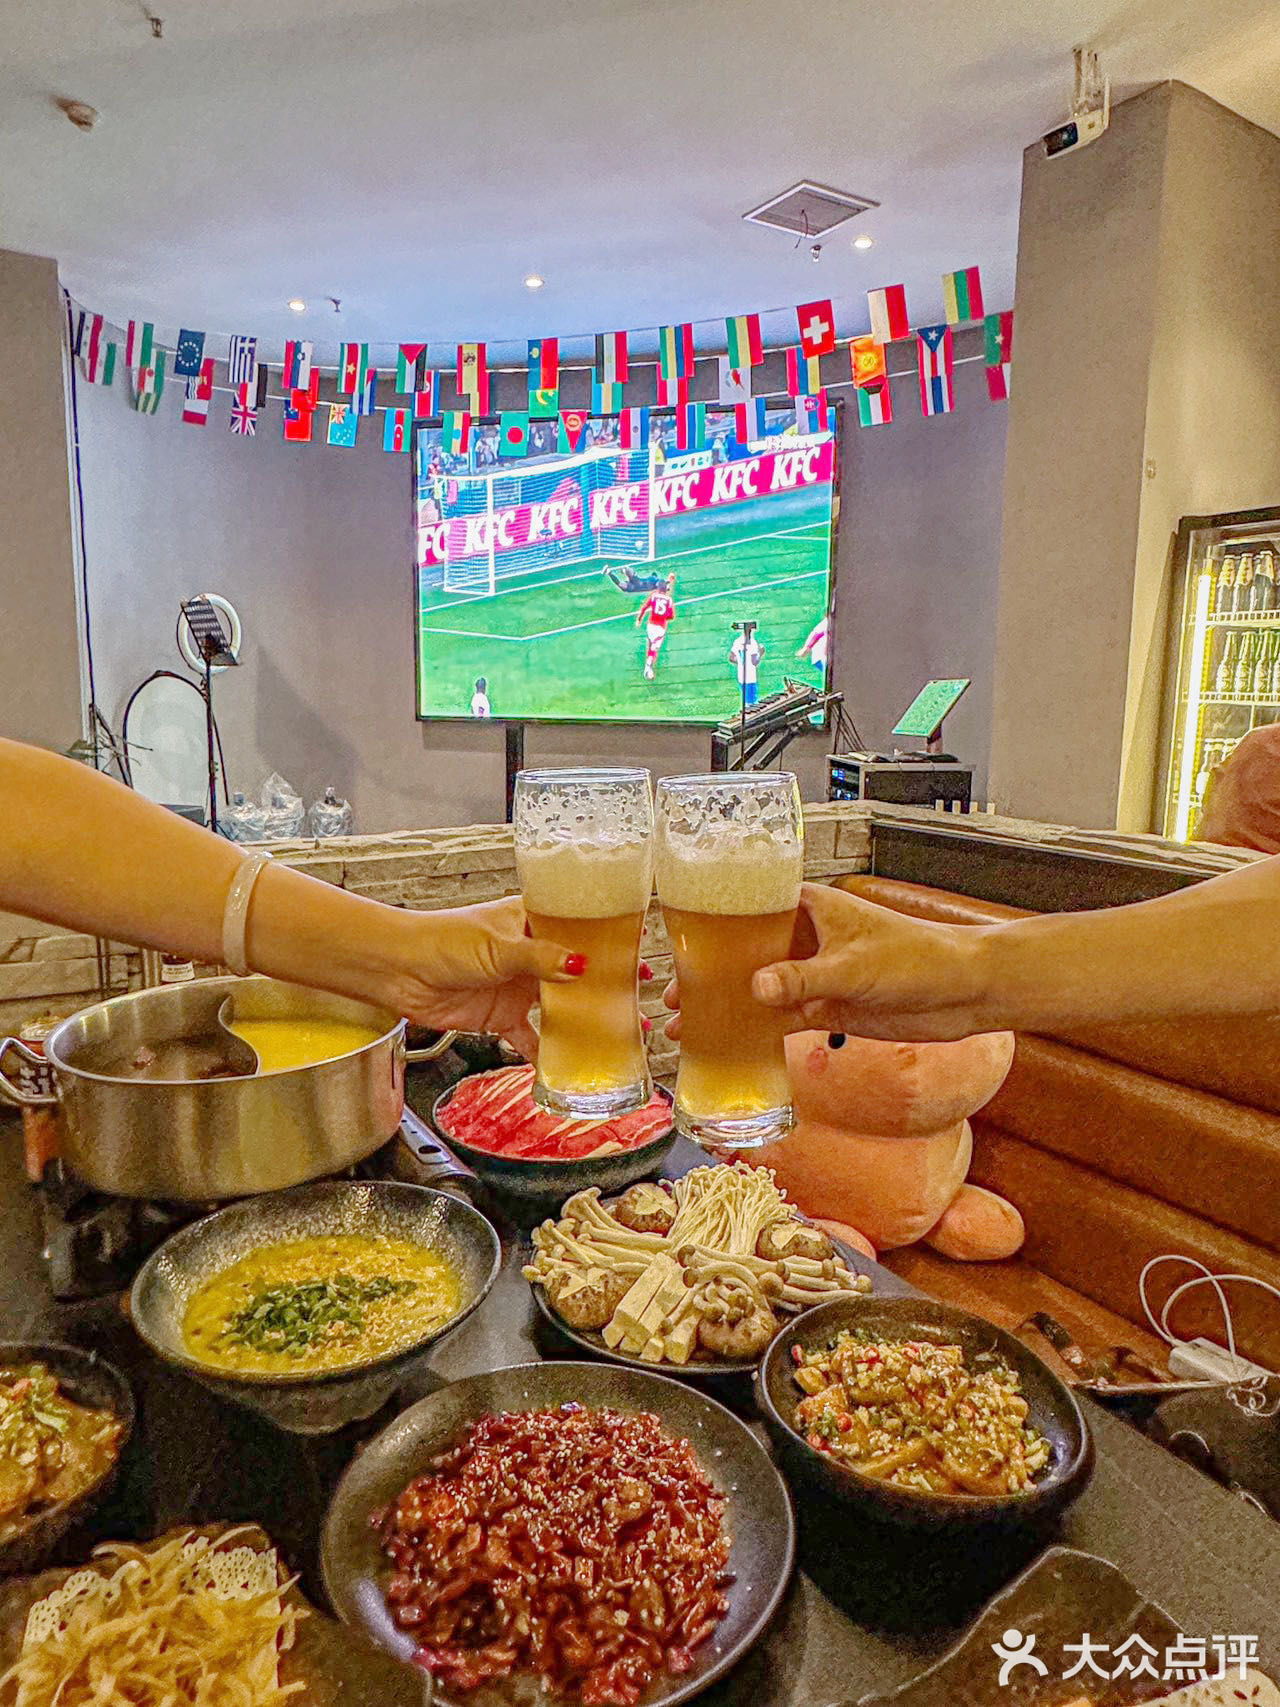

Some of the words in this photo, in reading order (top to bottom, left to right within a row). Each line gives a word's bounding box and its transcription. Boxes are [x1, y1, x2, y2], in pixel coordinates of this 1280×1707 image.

[463, 512, 515, 553] KFC
[527, 498, 578, 542] KFC
[590, 487, 640, 529] KFC
[653, 474, 700, 517] KFC
[710, 460, 760, 503] KFC
[770, 446, 821, 491] KFC
